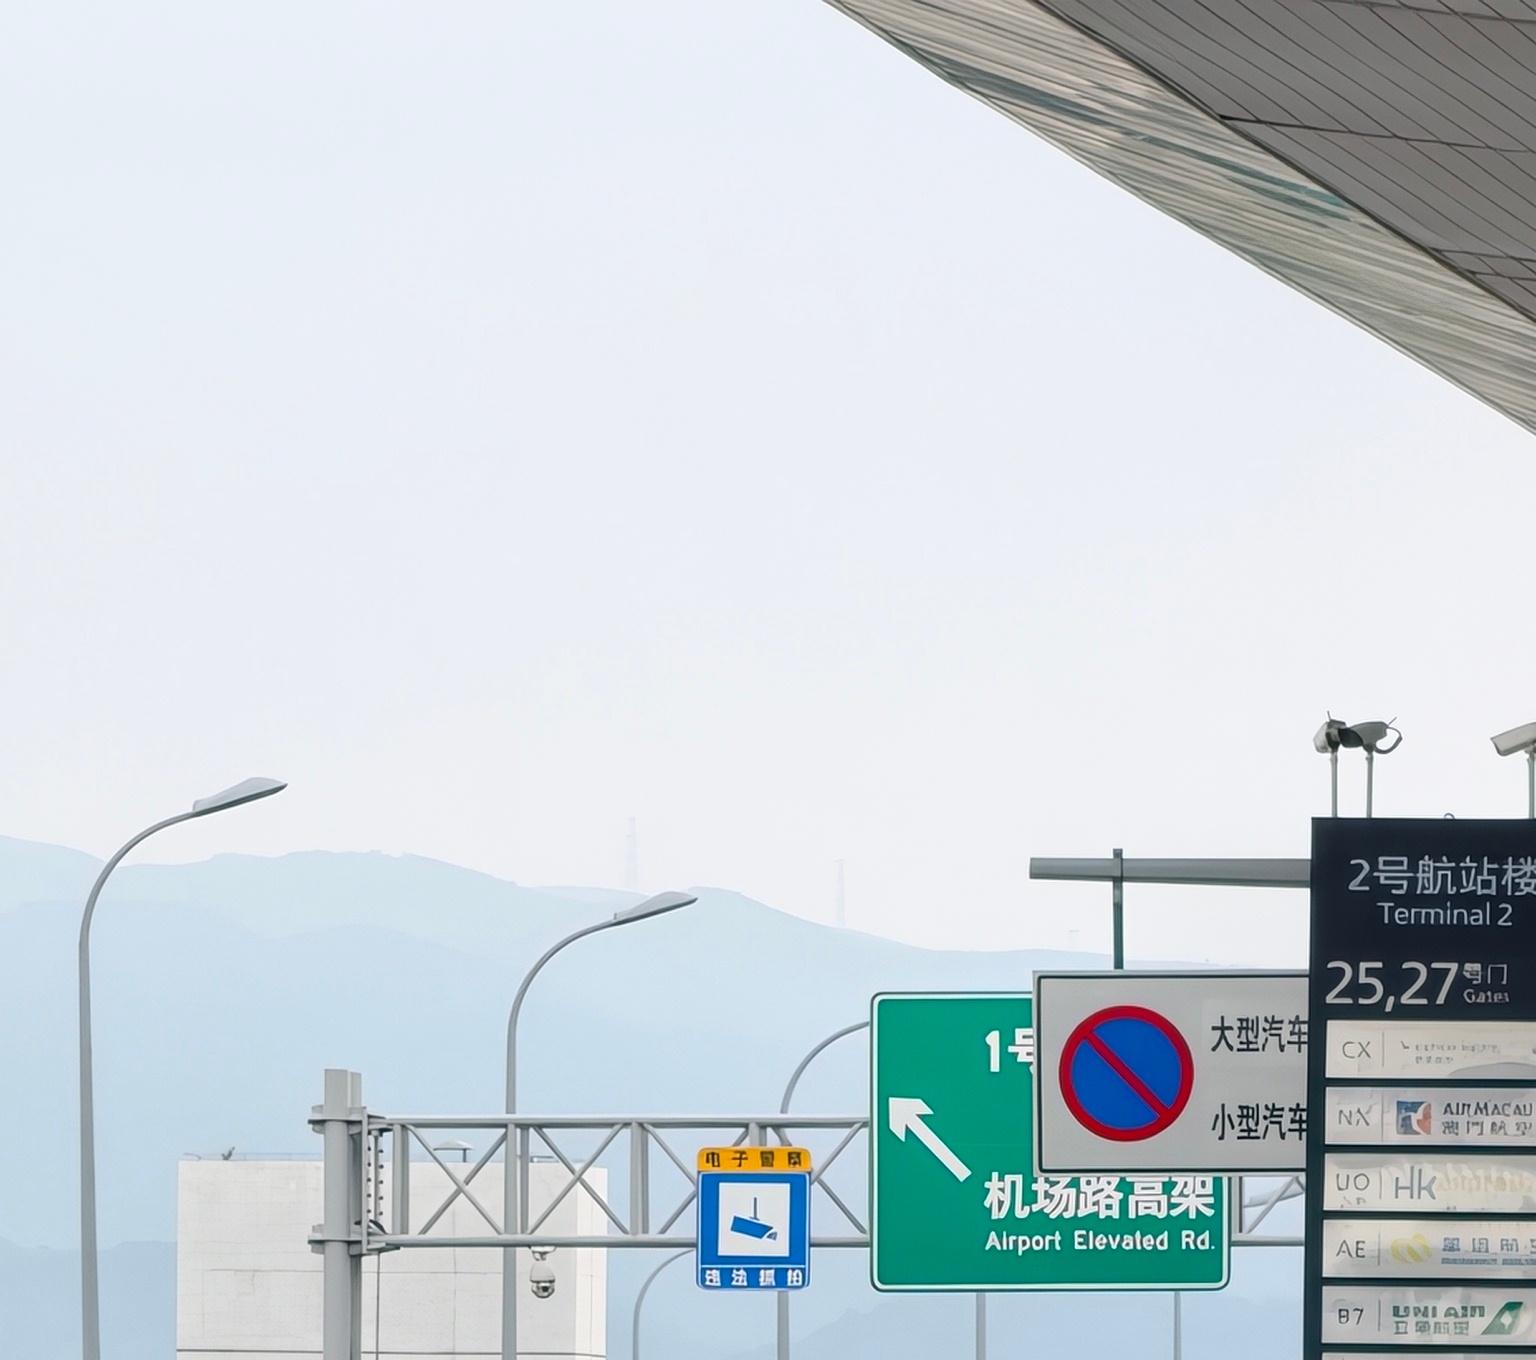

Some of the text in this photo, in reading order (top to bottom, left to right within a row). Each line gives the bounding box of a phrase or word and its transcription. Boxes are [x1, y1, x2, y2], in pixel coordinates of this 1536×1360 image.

[1348, 855, 1536, 896] 2号航站楼
[1377, 902, 1513, 926] Terminal 2
[1325, 960, 1458, 1012] 25,27
[1211, 1014, 1308, 1053] 大型汽车
[1342, 1041, 1372, 1060] CX
[1212, 1102, 1308, 1141] 小型汽车
[1338, 1107, 1371, 1128] NX
[705, 1150, 802, 1168] 电子
[1336, 1173, 1370, 1192] UO
[984, 1172, 1215, 1220] 机场路高架
[984, 1230, 1215, 1255] Airport Elevated Rd.
[1336, 1239, 1366, 1260] AE
[1337, 1307, 1365, 1327] B7
